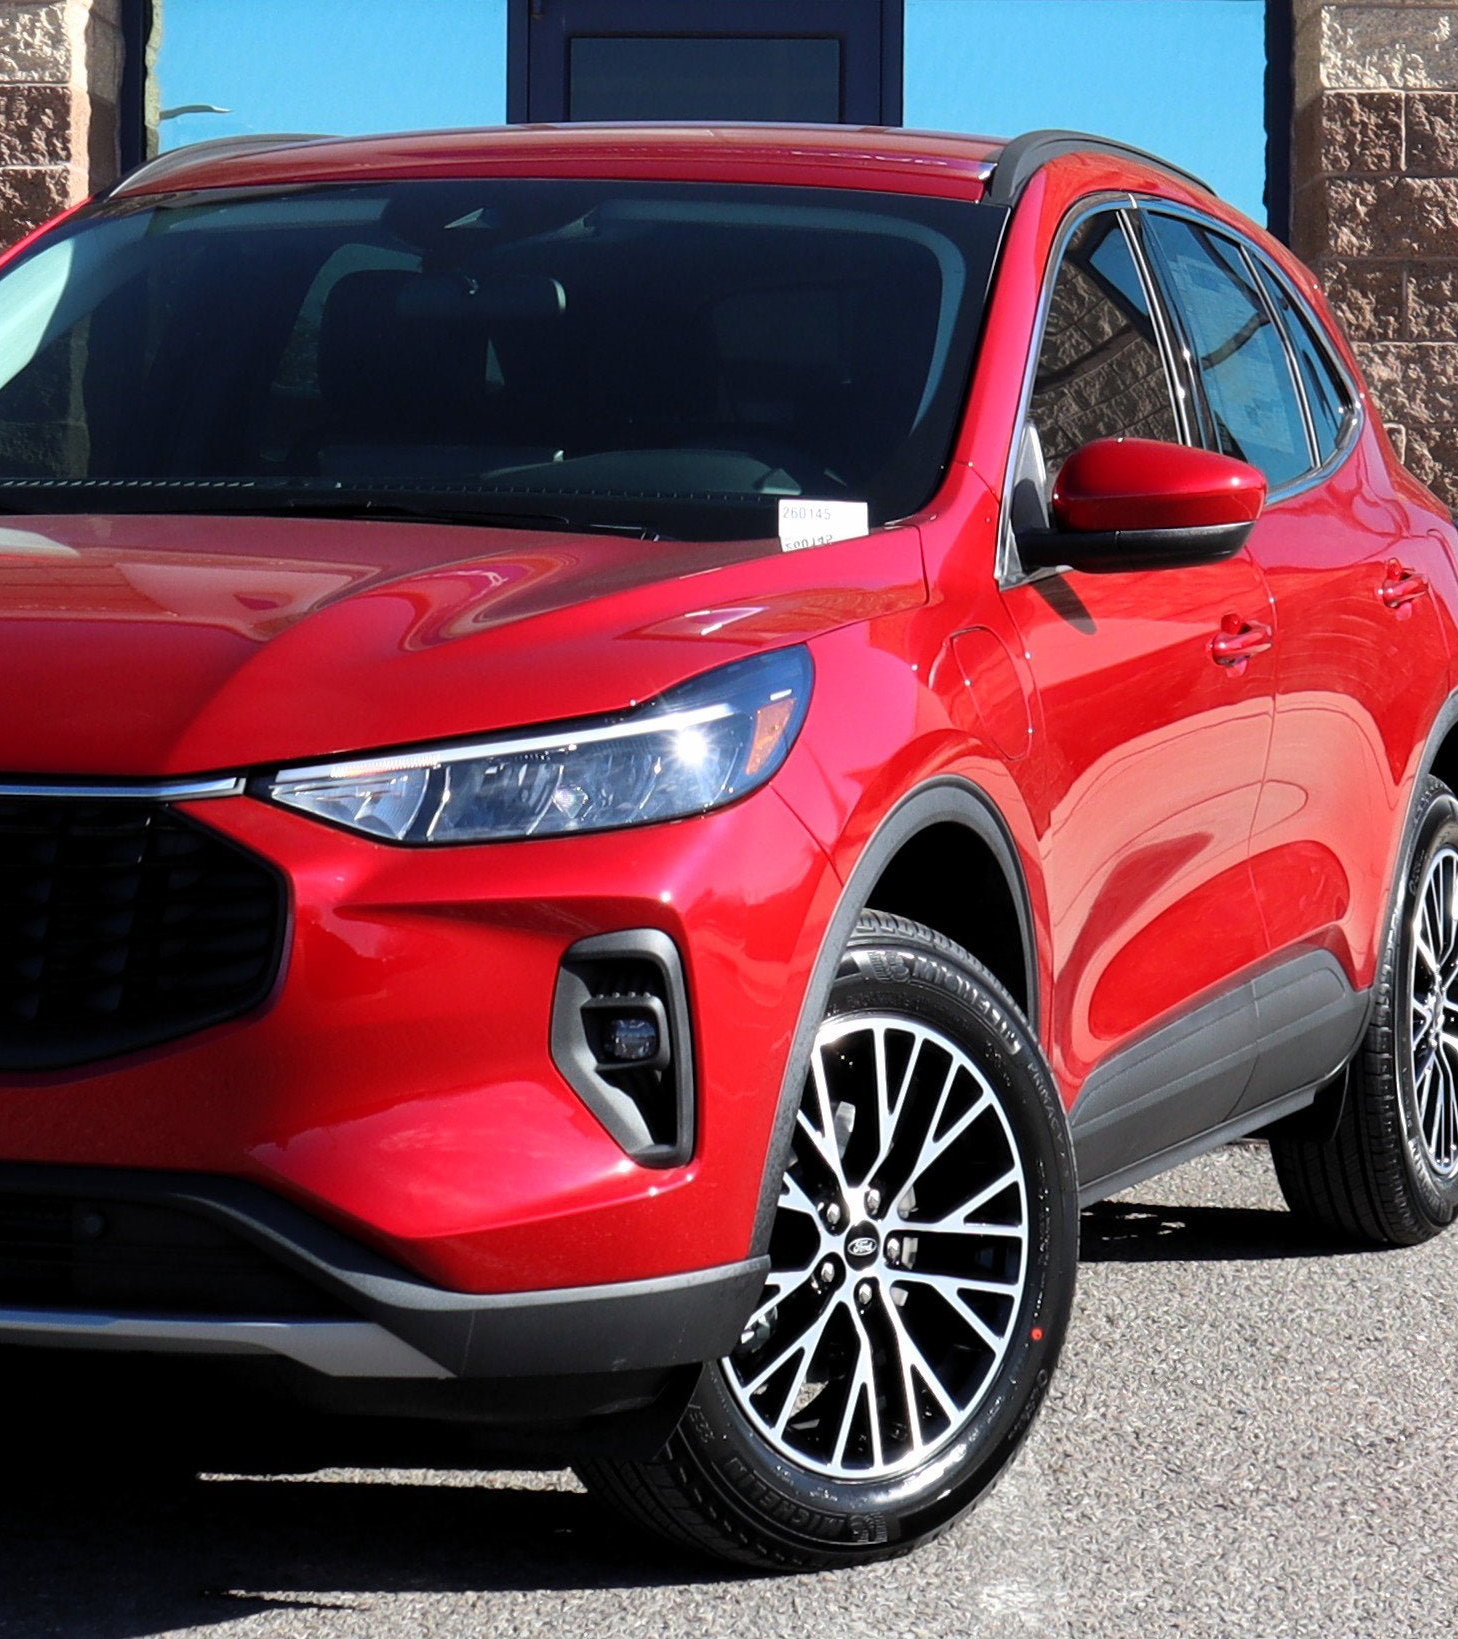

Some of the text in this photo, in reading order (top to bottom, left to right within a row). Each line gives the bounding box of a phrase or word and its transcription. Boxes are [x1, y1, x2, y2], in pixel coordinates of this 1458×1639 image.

[782, 505, 832, 520] 260145
[913, 955, 1022, 1056] MICHELIN
[1027, 1062, 1065, 1139] PRIMACY
[853, 1239, 874, 1253] Ford
[723, 1456, 845, 1536] MICHELIN
